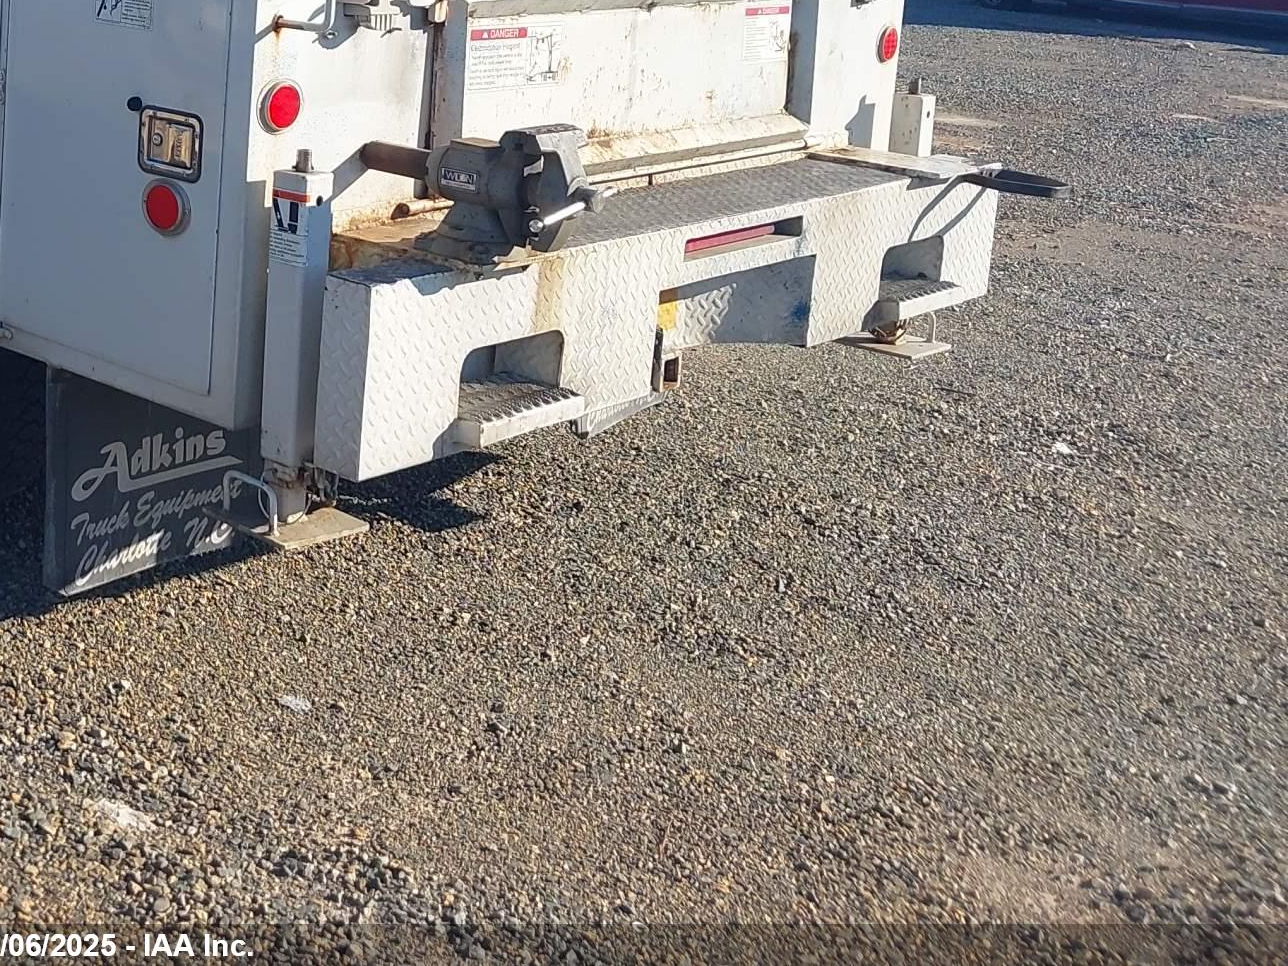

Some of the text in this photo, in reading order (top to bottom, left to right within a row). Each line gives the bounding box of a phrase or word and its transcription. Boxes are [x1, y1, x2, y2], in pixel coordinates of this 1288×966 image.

[490, 29, 519, 39] DANGER
[72, 427, 227, 501] Adkins
[71, 501, 130, 546] Truck
[75, 530, 172, 586] Charlotte
